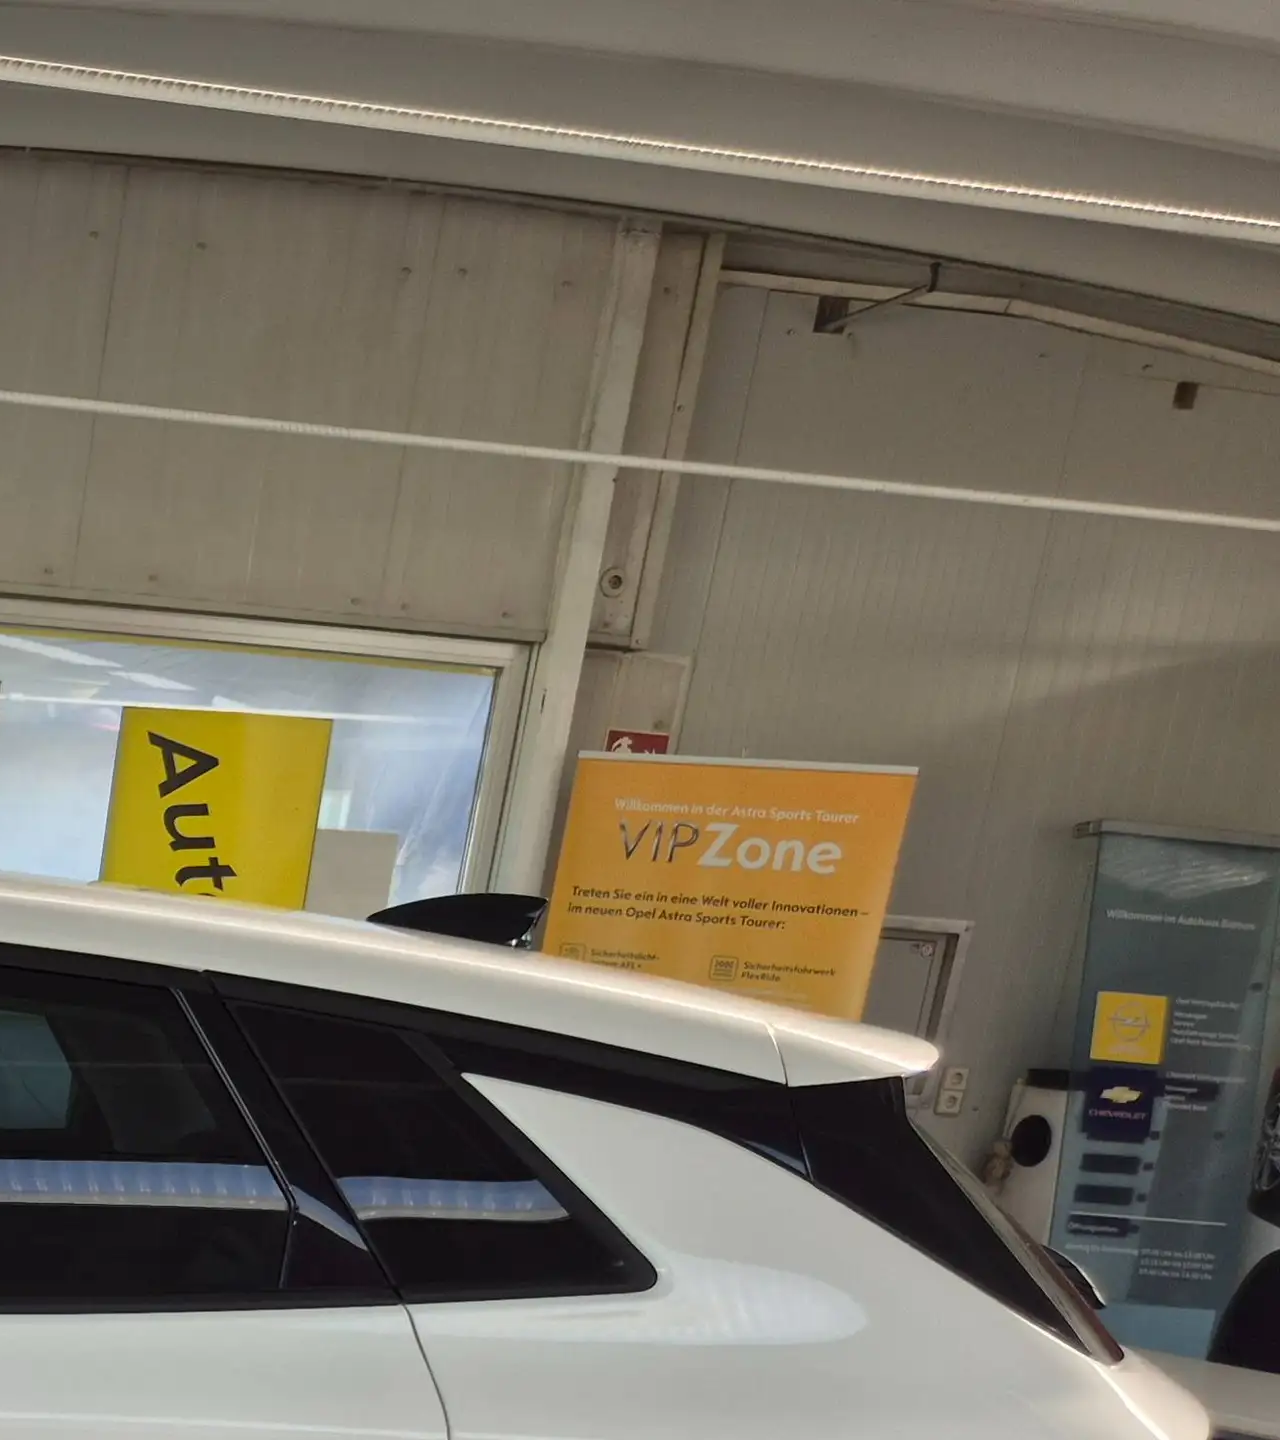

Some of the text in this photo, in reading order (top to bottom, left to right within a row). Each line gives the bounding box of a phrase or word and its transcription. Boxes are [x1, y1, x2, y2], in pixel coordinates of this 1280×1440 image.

[615, 798, 860, 825] Willkommen in der Astra Sports Tourer
[572, 885, 610, 900] Treten
[613, 888, 632, 900] Sie
[635, 889, 654, 902] ein
[656, 890, 668, 903] in
[671, 892, 698, 905] eine
[702, 894, 729, 908] Welt
[733, 897, 767, 911] voller
[771, 900, 858, 918] Innovationen
[585, 906, 622, 917] neuen
[625, 907, 656, 921] Opel
[658, 909, 692, 923] Astra
[695, 911, 737, 926] Sports
[740, 914, 786, 930] Tourer:
